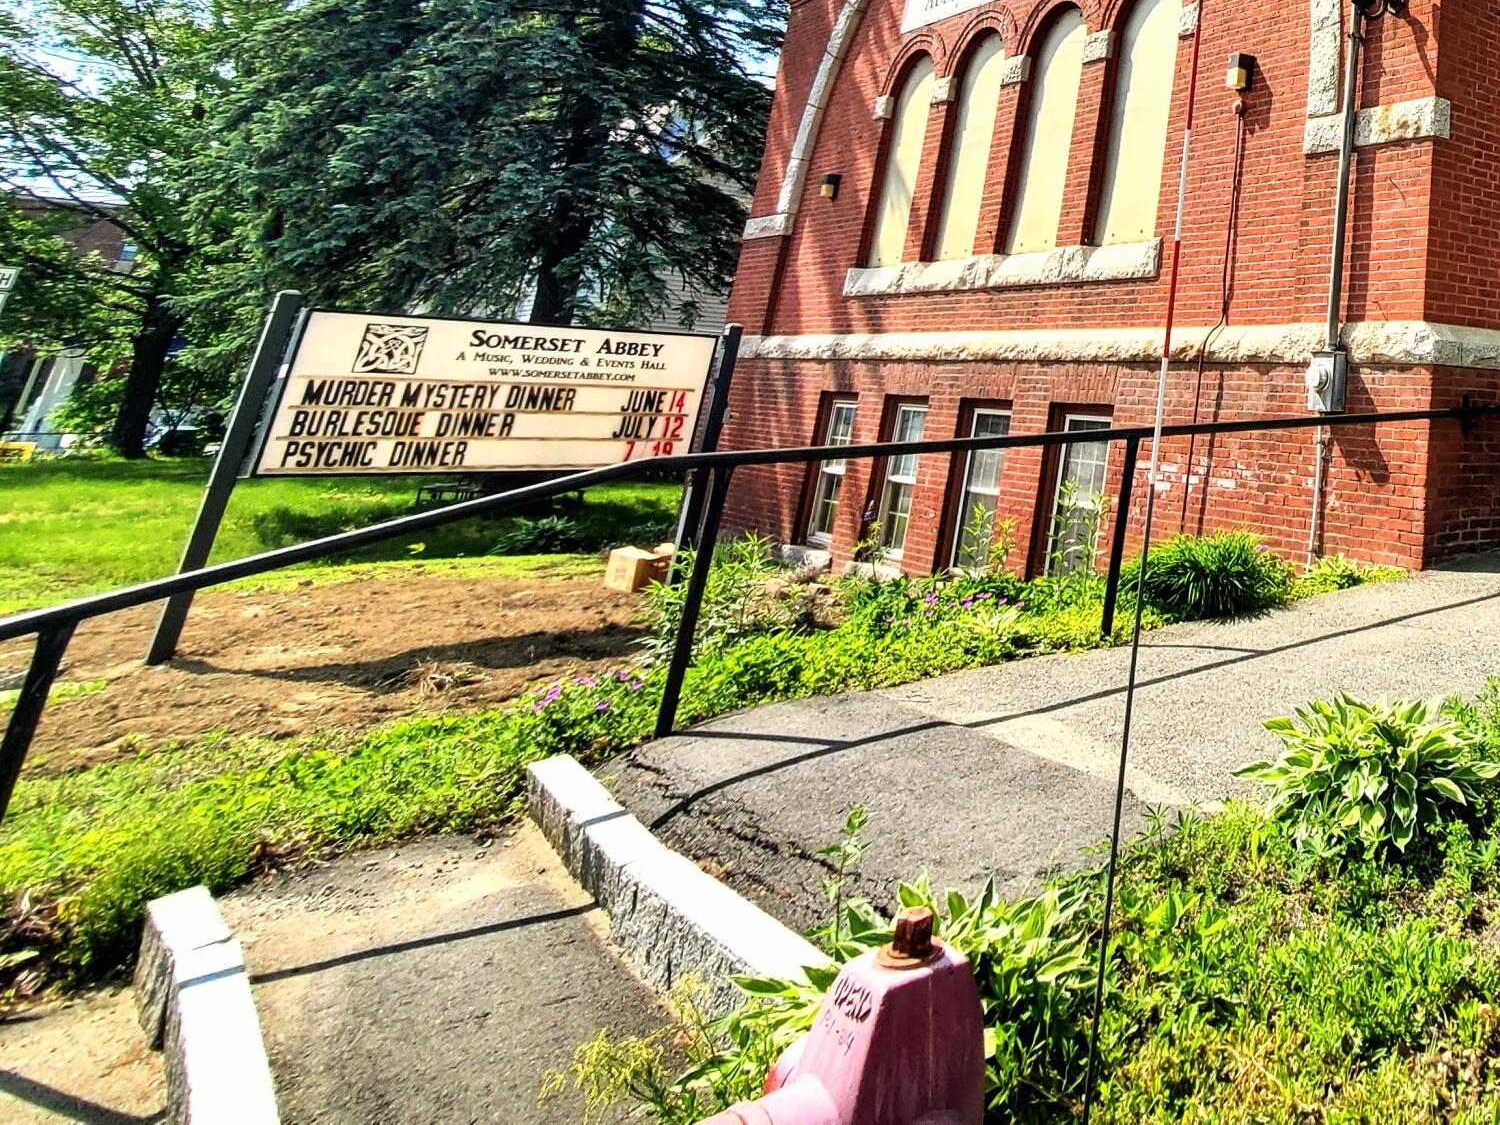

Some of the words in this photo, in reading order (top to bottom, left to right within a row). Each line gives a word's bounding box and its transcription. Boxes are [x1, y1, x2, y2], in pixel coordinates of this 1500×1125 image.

[469, 329, 586, 353] SOMERSET
[596, 338, 665, 357] ABBEY
[456, 351, 466, 361] A
[522, 354, 574, 366] WEDDING
[579, 357, 590, 366] &
[596, 358, 635, 369] EVENTS
[640, 360, 667, 370] HALL
[488, 368, 636, 382] WWW.SOMERSETABBEY.COM
[301, 380, 396, 406] MURDER
[400, 383, 500, 409] MYSTERY
[505, 385, 577, 411] DINNER
[621, 390, 667, 413] JUNE
[668, 390, 687, 413] 14
[435, 412, 516, 437] DINNER
[612, 416, 658, 439] JULY
[662, 416, 685, 438] 12
[280, 441, 377, 468] PSYCHIC
[388, 441, 468, 467] DINNER
